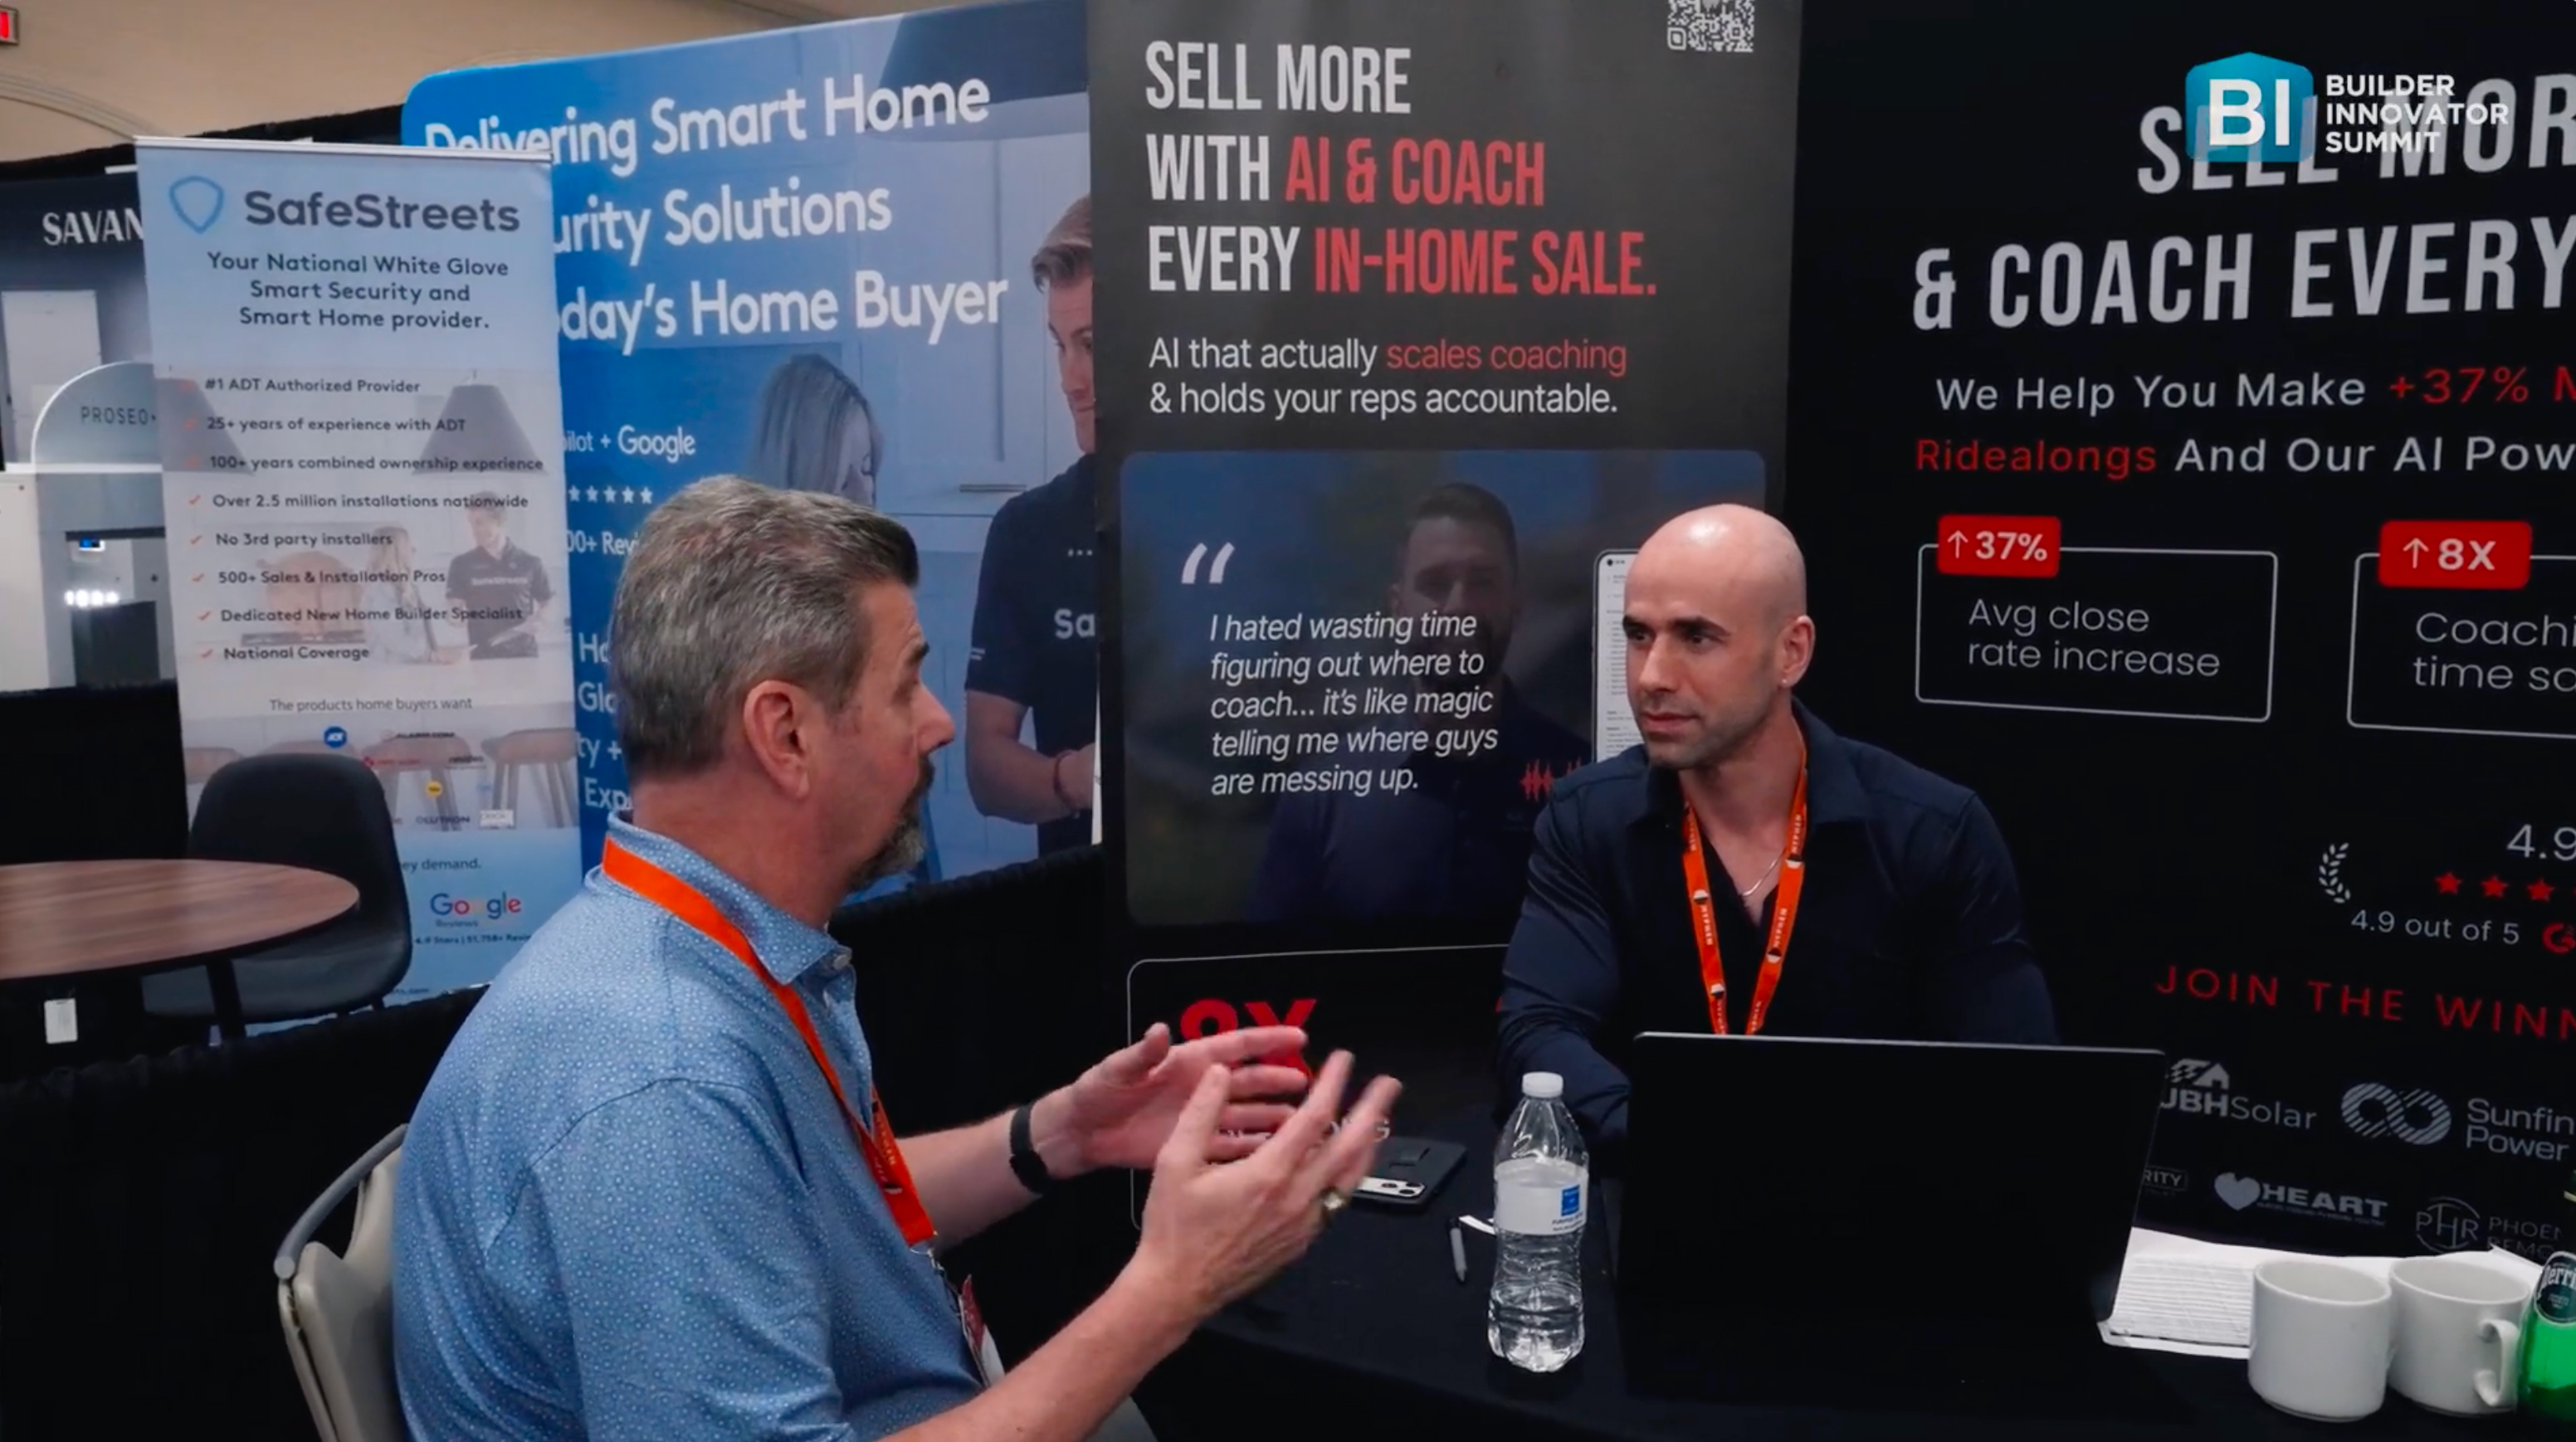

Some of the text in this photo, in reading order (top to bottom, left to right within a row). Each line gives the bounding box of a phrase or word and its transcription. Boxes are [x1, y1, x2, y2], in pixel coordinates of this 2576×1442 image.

[1145, 41, 1412, 114] SELL MORE
[651, 87, 807, 157] Smart
[824, 73, 991, 137] Home
[1145, 134, 1545, 207] WITH AI & COACH
[245, 190, 520, 232] SafeStreets
[665, 175, 892, 246] Solutions
[207, 251, 509, 276] Your National White Glove
[1149, 226, 1656, 296] EVERY IN-HOME SALE.
[1913, 215, 2576, 330] & COACH EVERY
[251, 280, 471, 304] Smart Security and
[240, 308, 490, 331] Smart Home provider.
[558, 270, 1009, 356] day's Home Buyer
[1149, 339, 1627, 378] AI that actually scales coaching
[206, 379, 420, 392] #1 ADT Authorized Provider
[1150, 382, 1618, 421] & holds your reps accountable.
[1935, 366, 2530, 417] We Help You Make +37%
[207, 418, 466, 433] 25+ years of experience with ADT
[617, 425, 696, 463] Google
[1916, 436, 2576, 480] Ridealongs And Our AI Pow
[210, 456, 544, 471] 100+ years combined ownership experience
[213, 495, 528, 508] Over 2.5 million installations nationwide
[216, 533, 393, 548] No 3rd party installers
[1975, 532, 2047, 563] 37%
[2437, 538, 2496, 572] 8X
[218, 571, 445, 583] 500+ Sales & Installation Pros
[222, 607, 523, 621] Dedicated New Home Builder Specialist
[1210, 610, 1477, 645] I hated wasting time
[1969, 598, 2149, 636] Avg close
[224, 648, 369, 661] National Coverage
[1210, 649, 1485, 684] figuring out where to
[1969, 638, 2221, 677] rate increase
[2413, 655, 2514, 690] time
[270, 698, 471, 714] The products home buyers want
[1210, 690, 1315, 719] coach...
[1364, 686, 1408, 715] like
[1413, 688, 1495, 719] magic
[1212, 726, 1499, 762] telling me where guys
[1210, 765, 1420, 797] are messing up.
[422, 858, 481, 870] demand.
[430, 891, 522, 920] Google
[2350, 909, 2520, 944] 4.9 out of 5
[2157, 966, 2278, 1006] JOIN
[2308, 981, 2403, 1021] THE
[2467, 1097, 2574, 1135] Sunfin
[2466, 1125, 2569, 1162] Power
[2261, 1183, 2388, 1218] HEART
